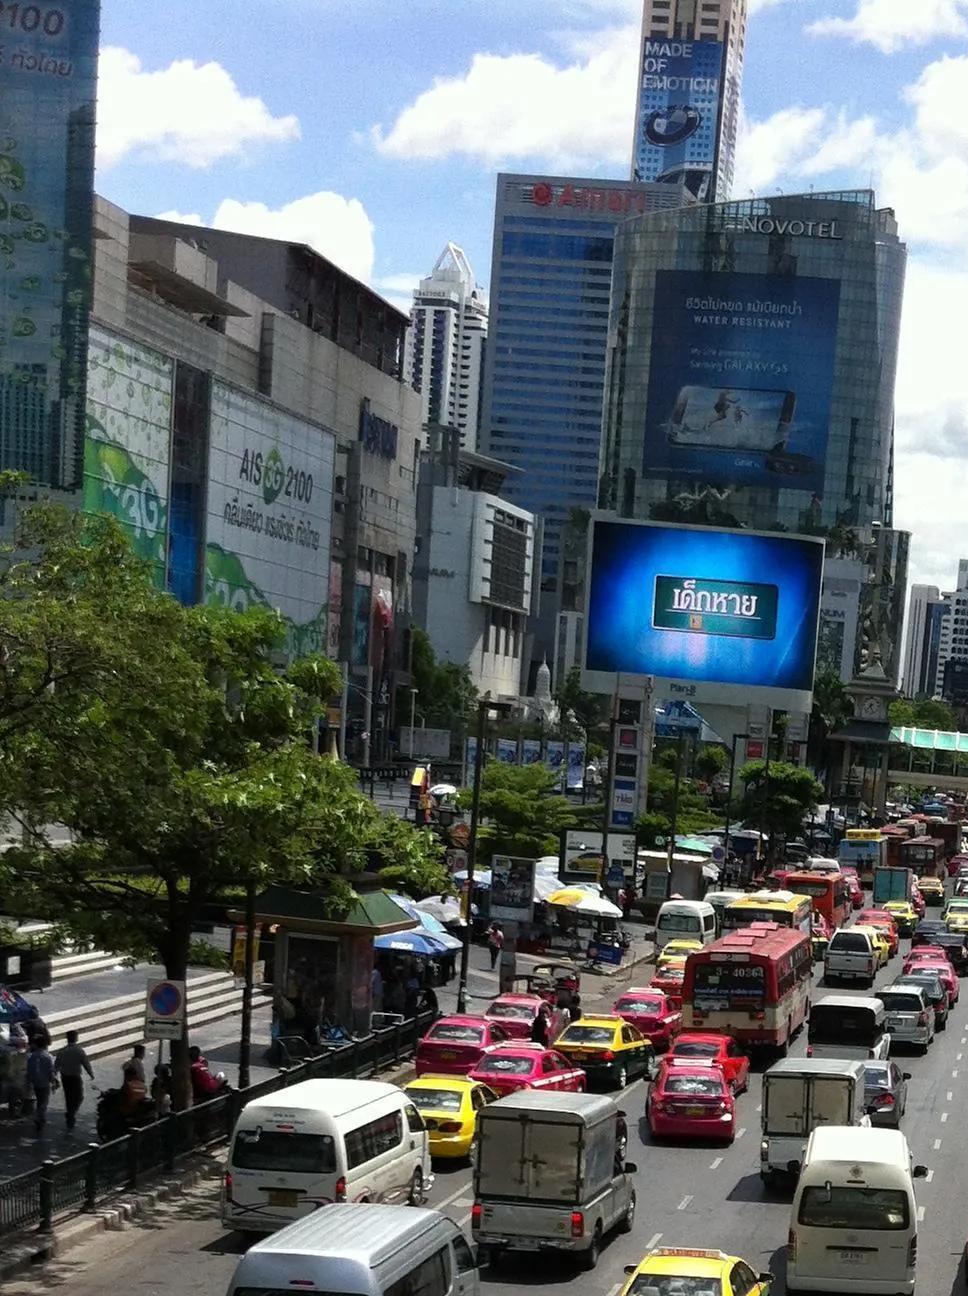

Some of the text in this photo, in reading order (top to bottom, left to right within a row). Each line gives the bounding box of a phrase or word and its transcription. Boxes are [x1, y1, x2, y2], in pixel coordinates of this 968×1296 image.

[644, 41, 693, 58] MADE
[644, 58, 667, 73] OF
[642, 75, 718, 93] EMOTION
[741, 215, 843, 239] NOVOTEL
[693, 315, 792, 329] WATER RESISTANT
[239, 448, 263, 486] AIS
[285, 466, 313, 503] 2100
[672, 579, 758, 616] เด็กหาย
